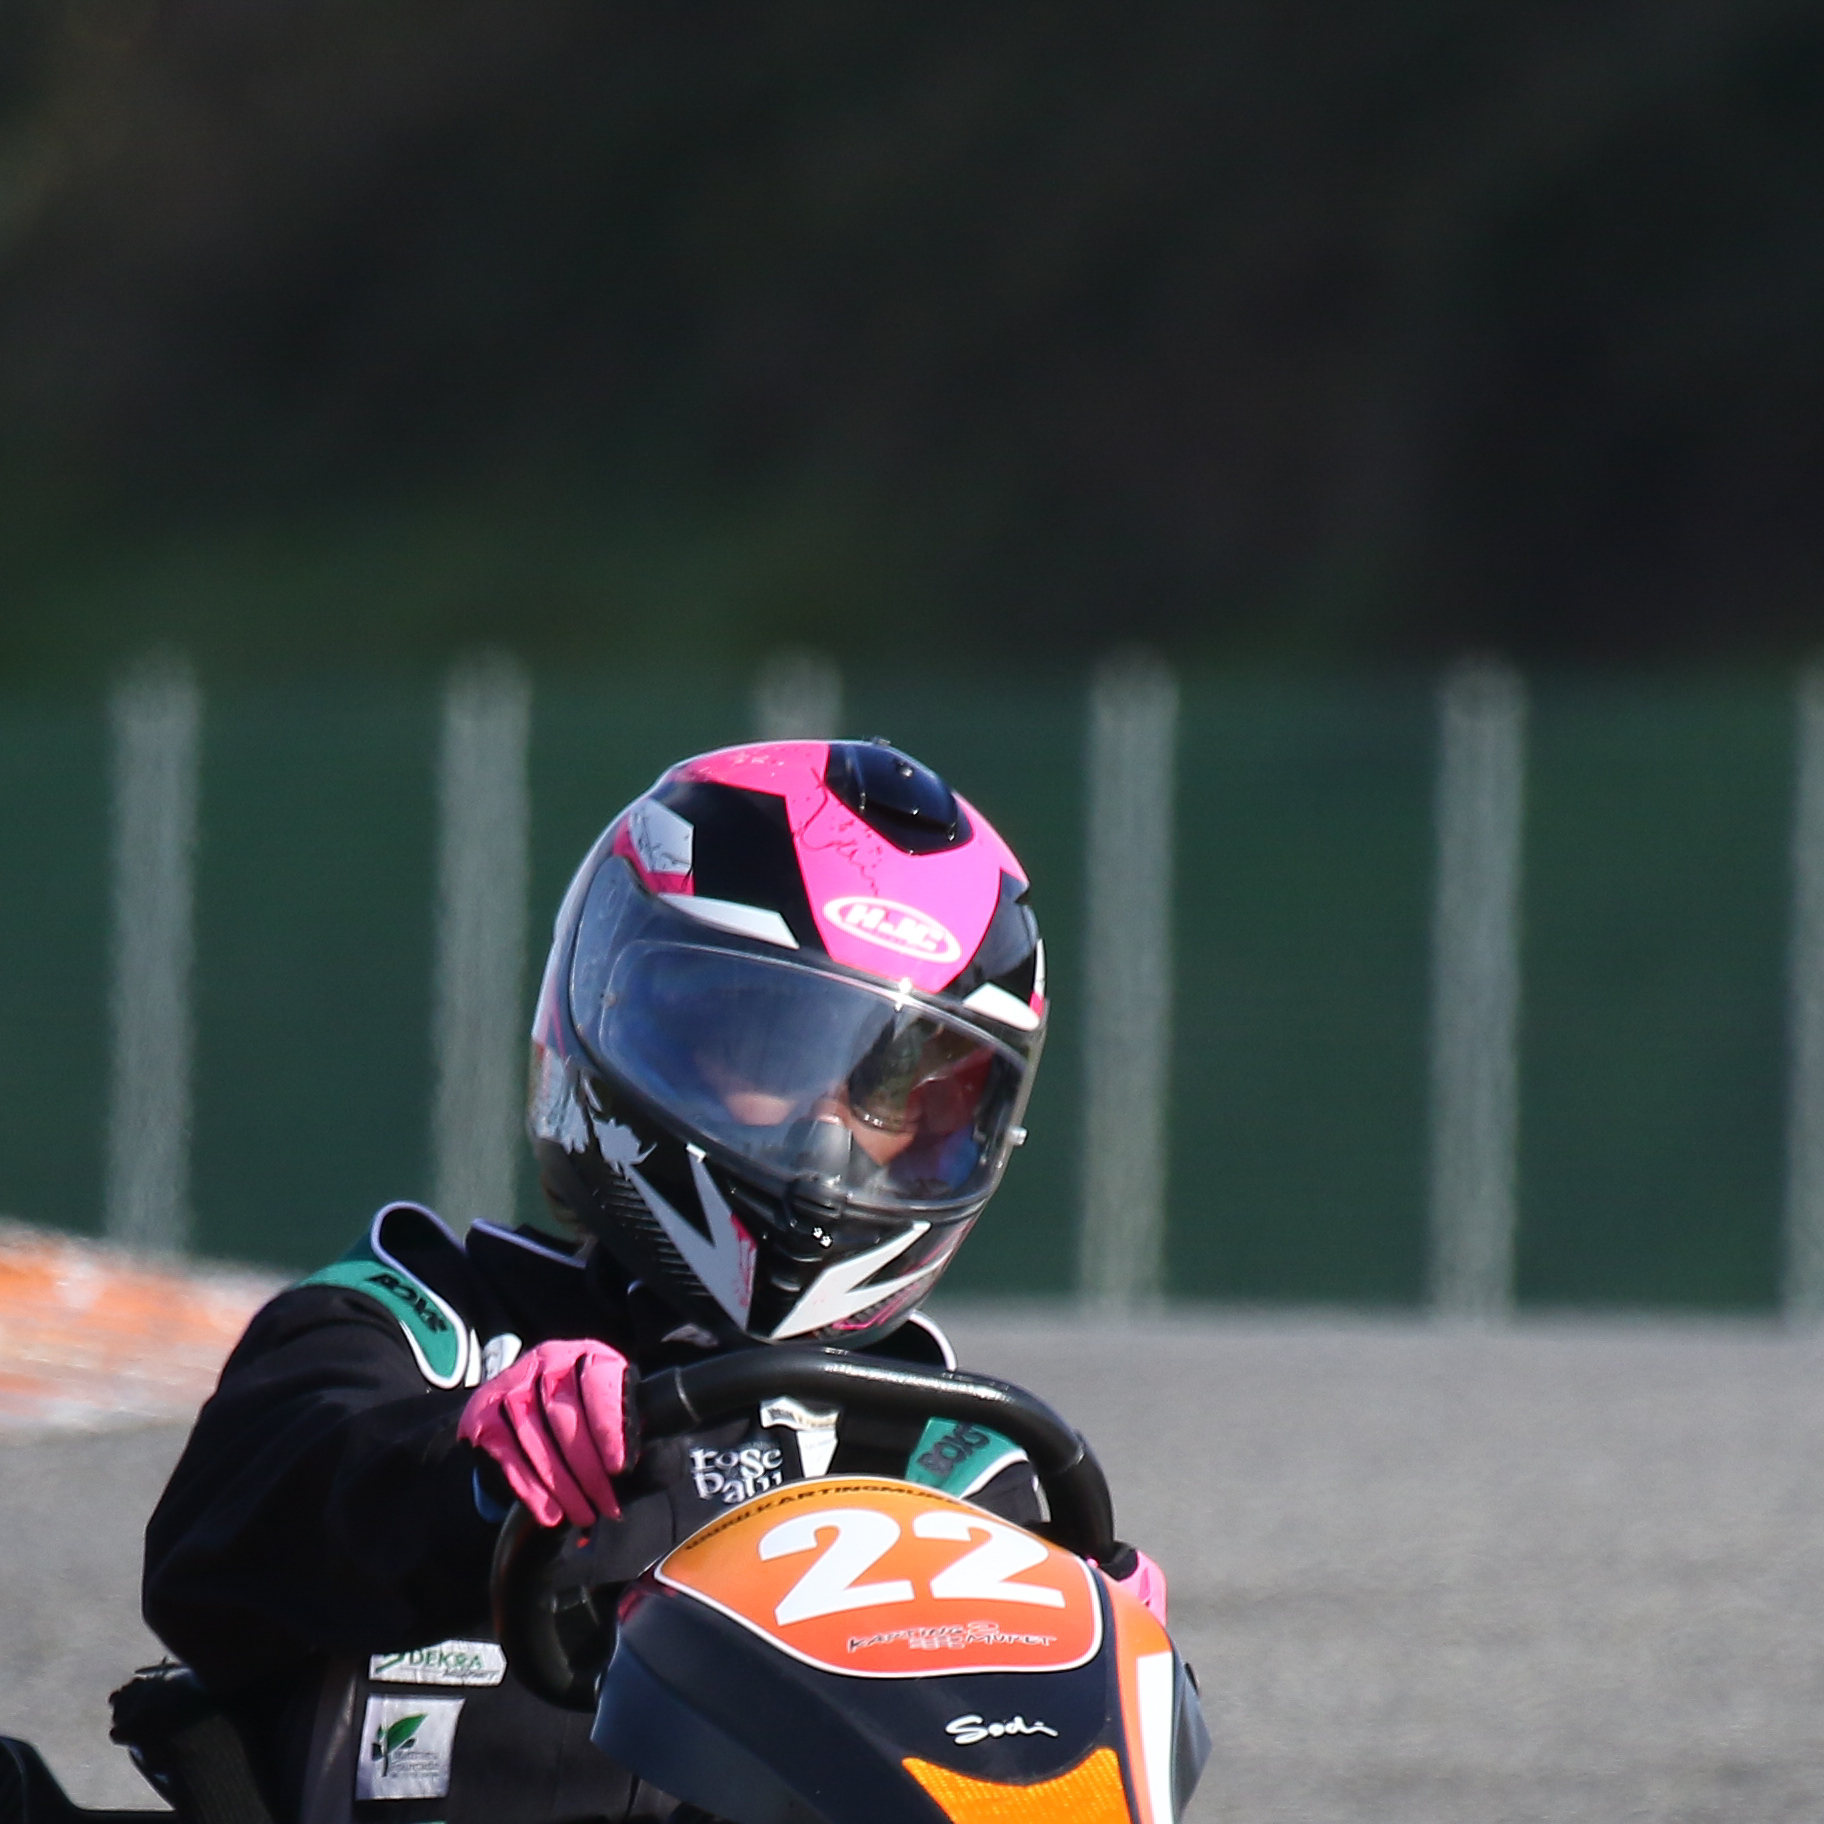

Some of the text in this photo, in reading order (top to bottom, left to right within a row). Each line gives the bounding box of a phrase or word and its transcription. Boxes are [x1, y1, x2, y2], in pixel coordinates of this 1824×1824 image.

[845, 903, 944, 951] HJC
[757, 1508, 1063, 1627] 22
[408, 1650, 483, 1670] DEKRA
[944, 1713, 1060, 1746] Sodi
